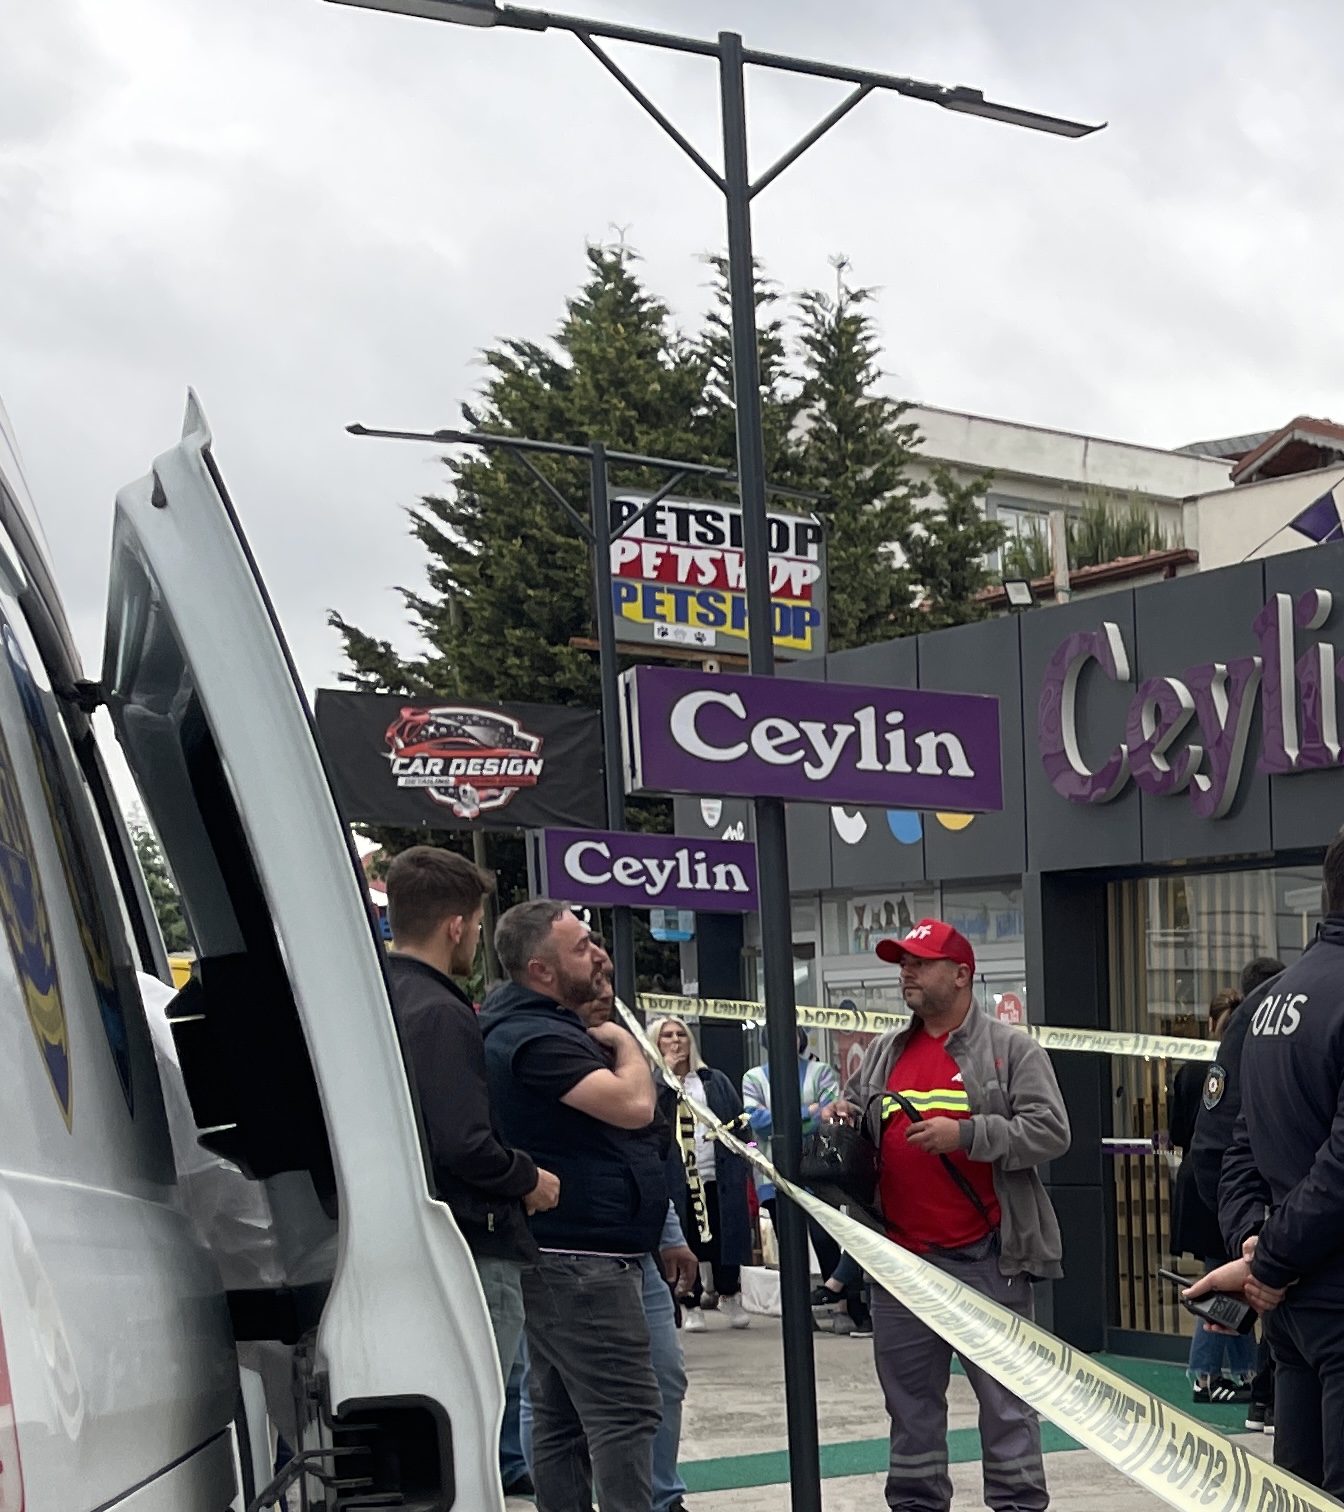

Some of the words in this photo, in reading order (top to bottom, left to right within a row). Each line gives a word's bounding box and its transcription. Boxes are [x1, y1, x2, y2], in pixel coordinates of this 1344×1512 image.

[669, 690, 975, 781] Ceylin
[392, 758, 444, 776] CAR
[450, 759, 543, 776] DESIGN
[564, 840, 750, 896] Ceylin
[1251, 993, 1308, 1036] OLİS
